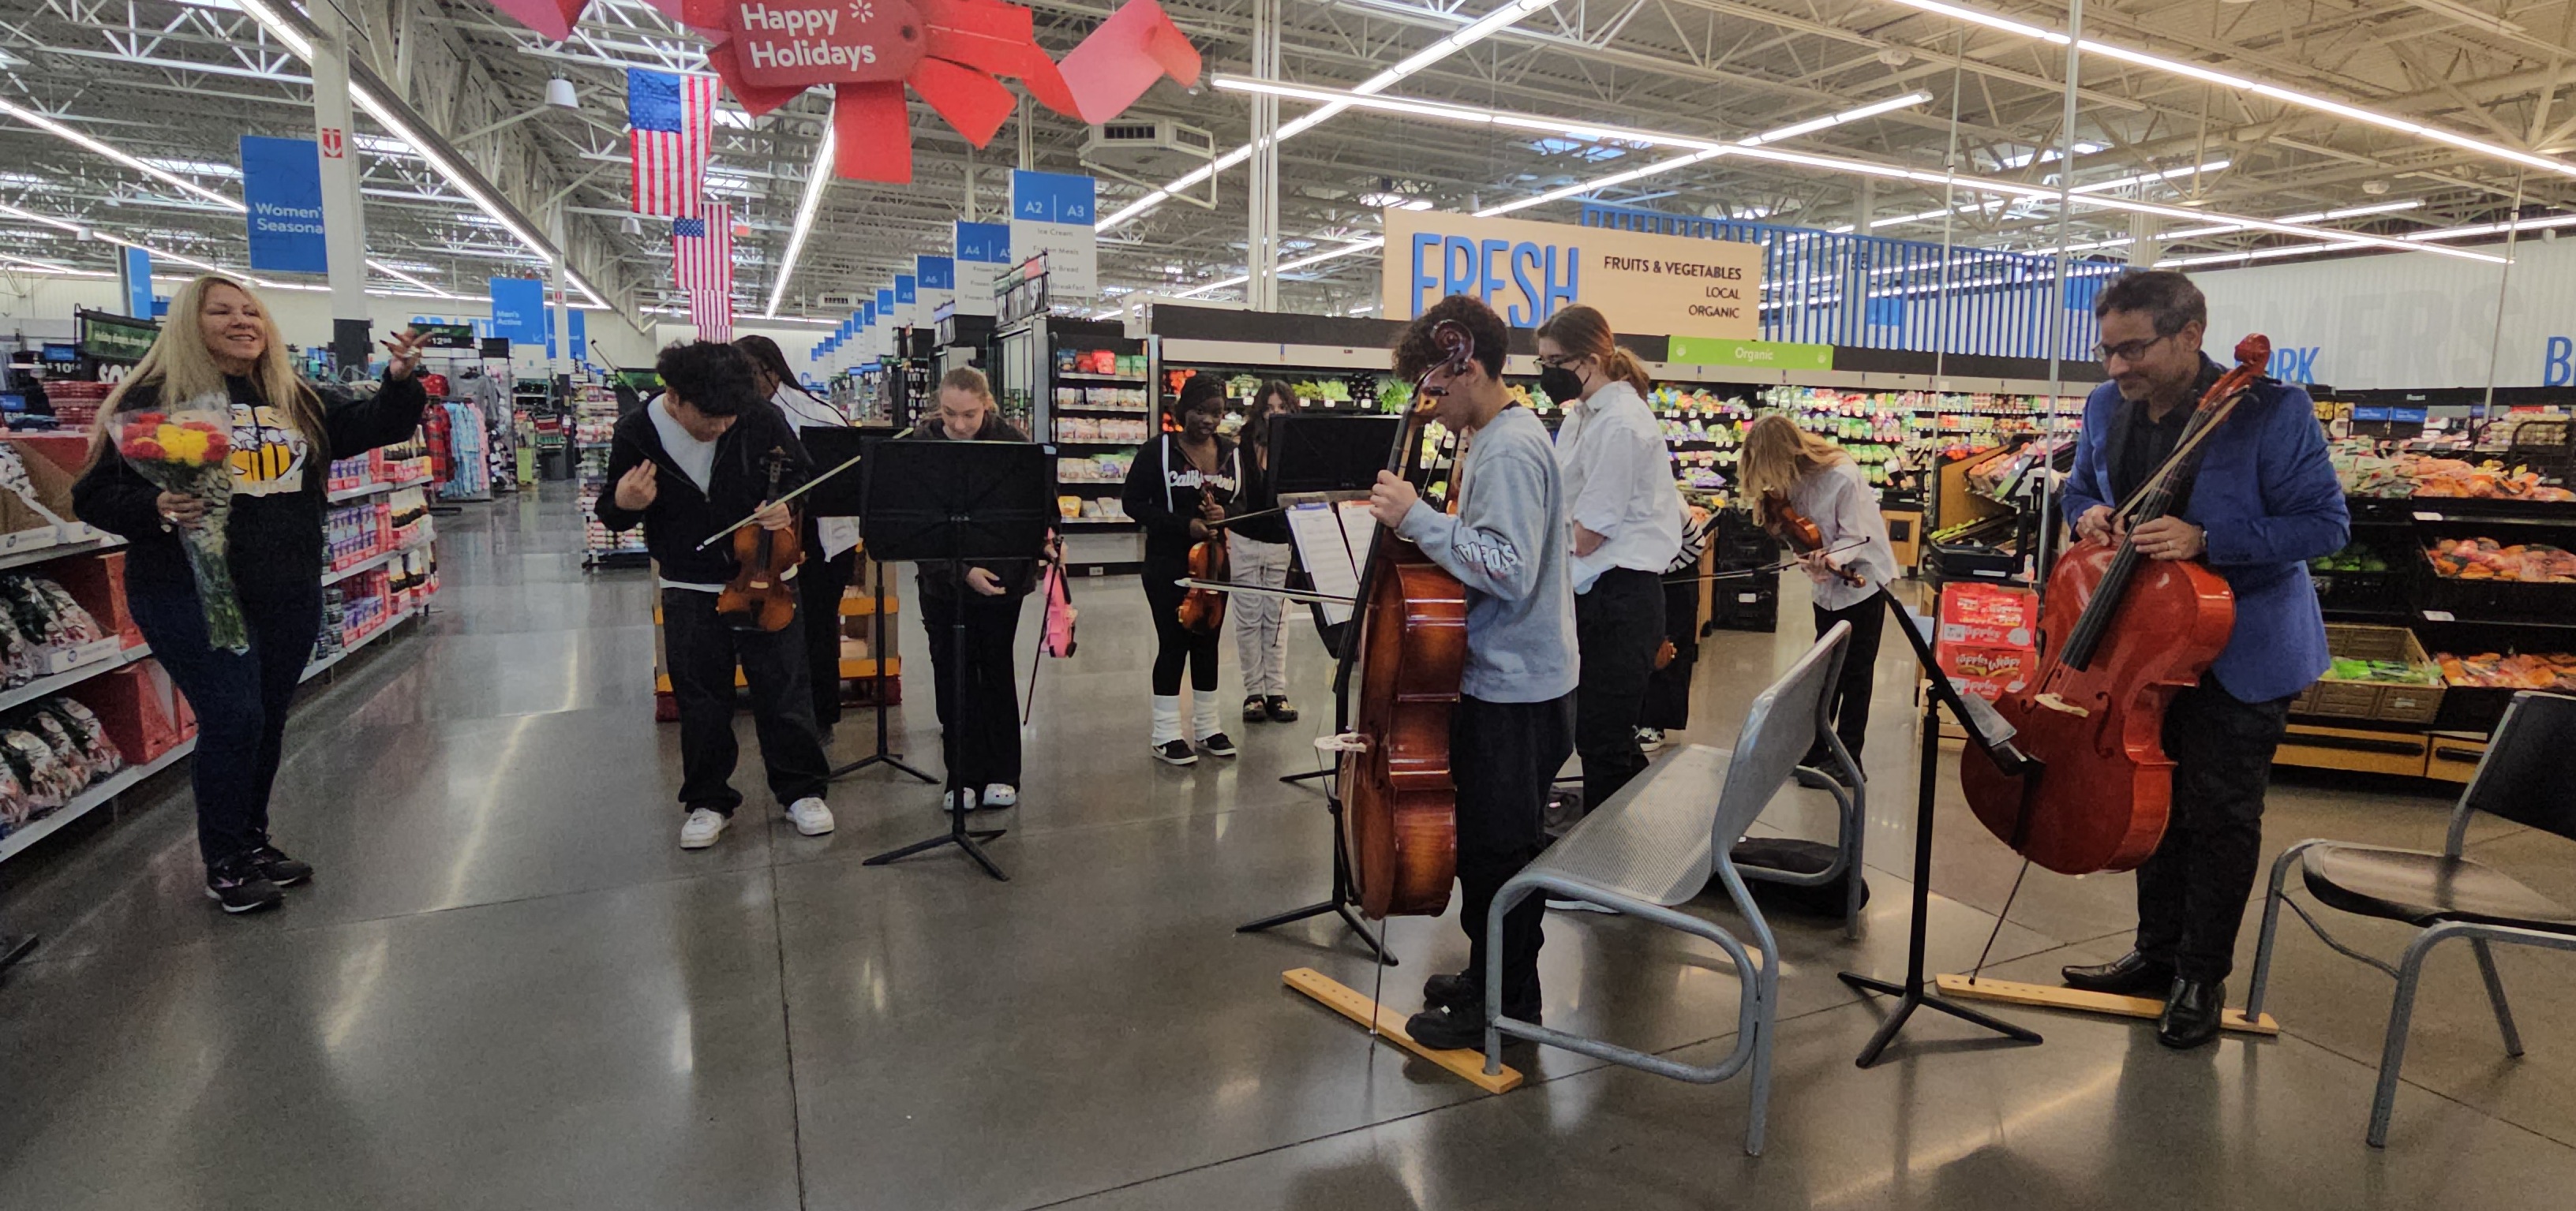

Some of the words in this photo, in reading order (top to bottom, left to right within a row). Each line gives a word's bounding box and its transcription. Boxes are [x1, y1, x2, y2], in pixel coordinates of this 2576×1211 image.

[741, 3, 838, 36] Happy
[750, 39, 876, 72] Holidays
[255, 202, 323, 219] Women'
[1024, 201, 1043, 214] A2
[1067, 205, 1084, 217] A3
[256, 218, 324, 234] Seasona
[1050, 228, 1073, 237] Cream
[964, 245, 980, 256] A4
[1604, 256, 1649, 273] FRUITS
[1653, 260, 1661, 274] &
[1664, 261, 1742, 280] VEGETABLES
[1411, 233, 1578, 328] FRESH
[1705, 286, 1741, 300] LOCAL
[1688, 305, 1740, 319] ORGANIC
[1735, 347, 1773, 362] Organic
[2544, 336, 2576, 387] B
